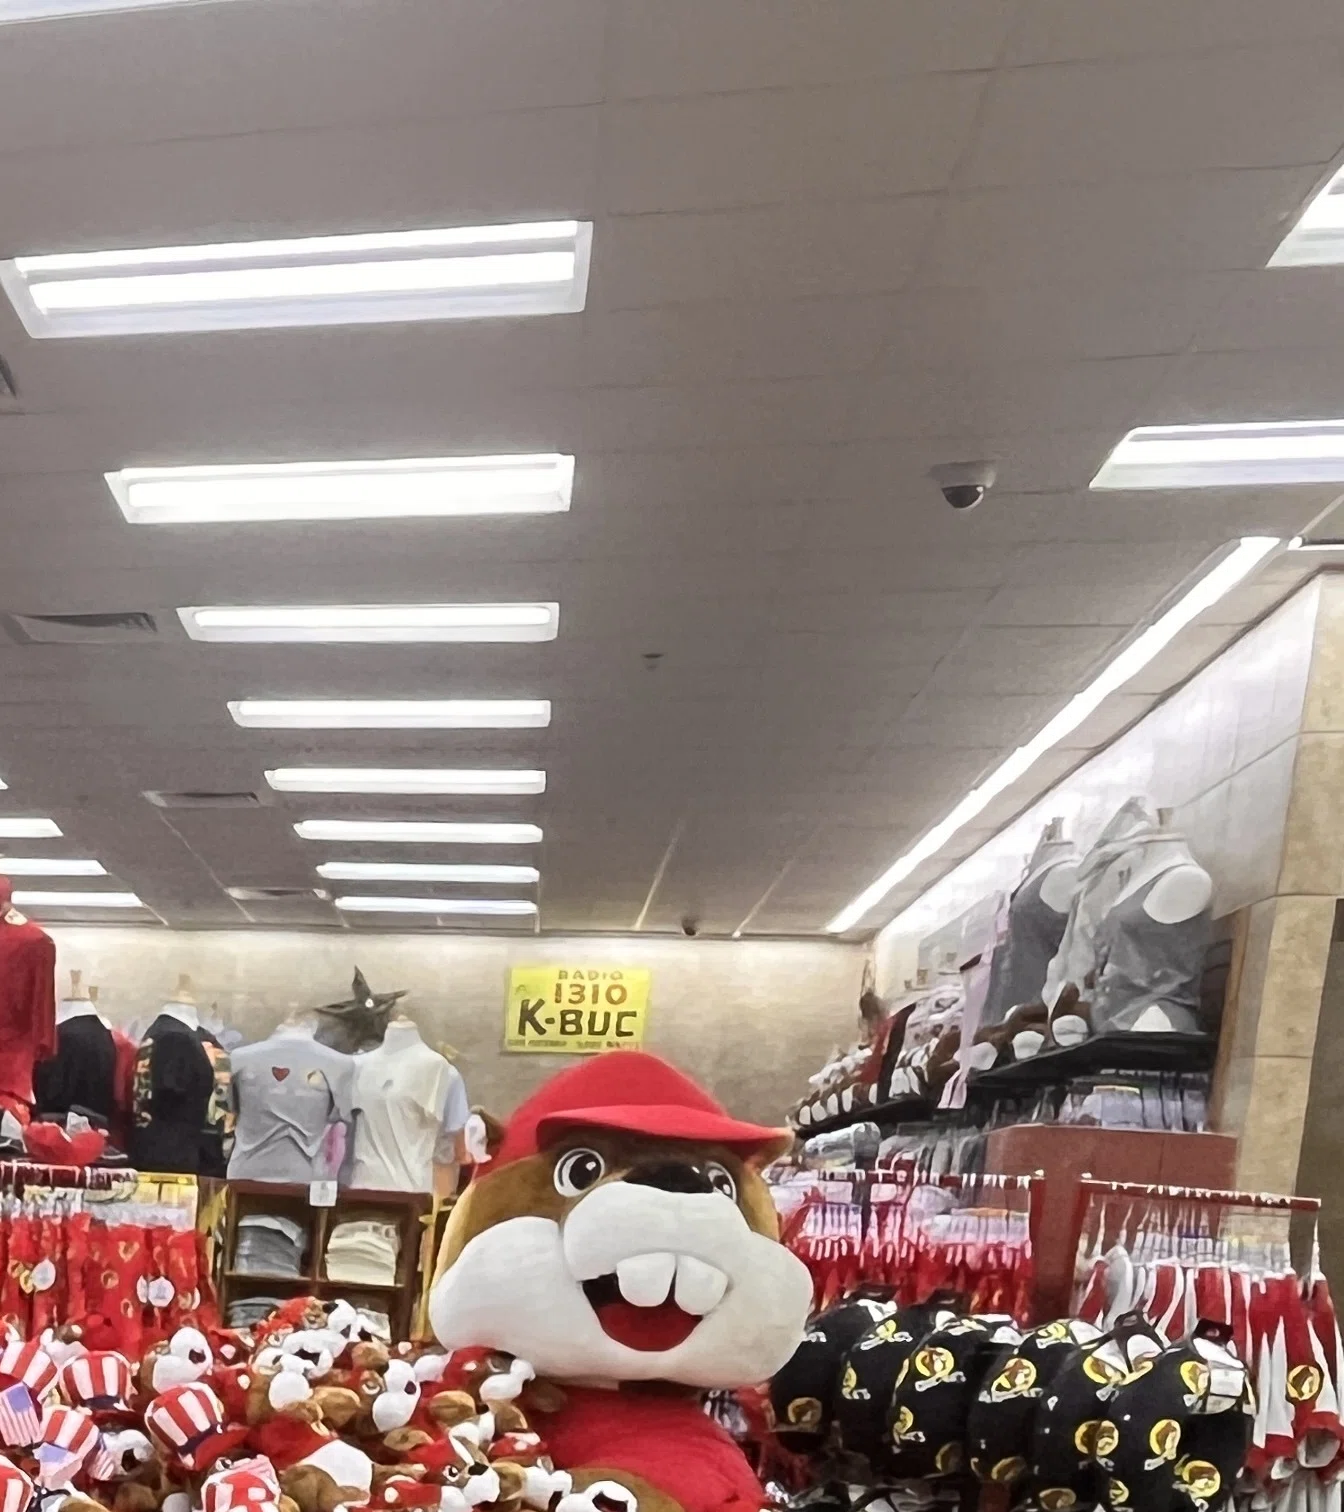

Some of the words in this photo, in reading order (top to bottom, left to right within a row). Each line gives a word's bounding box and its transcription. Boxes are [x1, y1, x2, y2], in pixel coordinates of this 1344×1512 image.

[558, 969, 624, 981] RADIO
[554, 983, 628, 1005] 1310
[518, 998, 637, 1037] K-BUC
